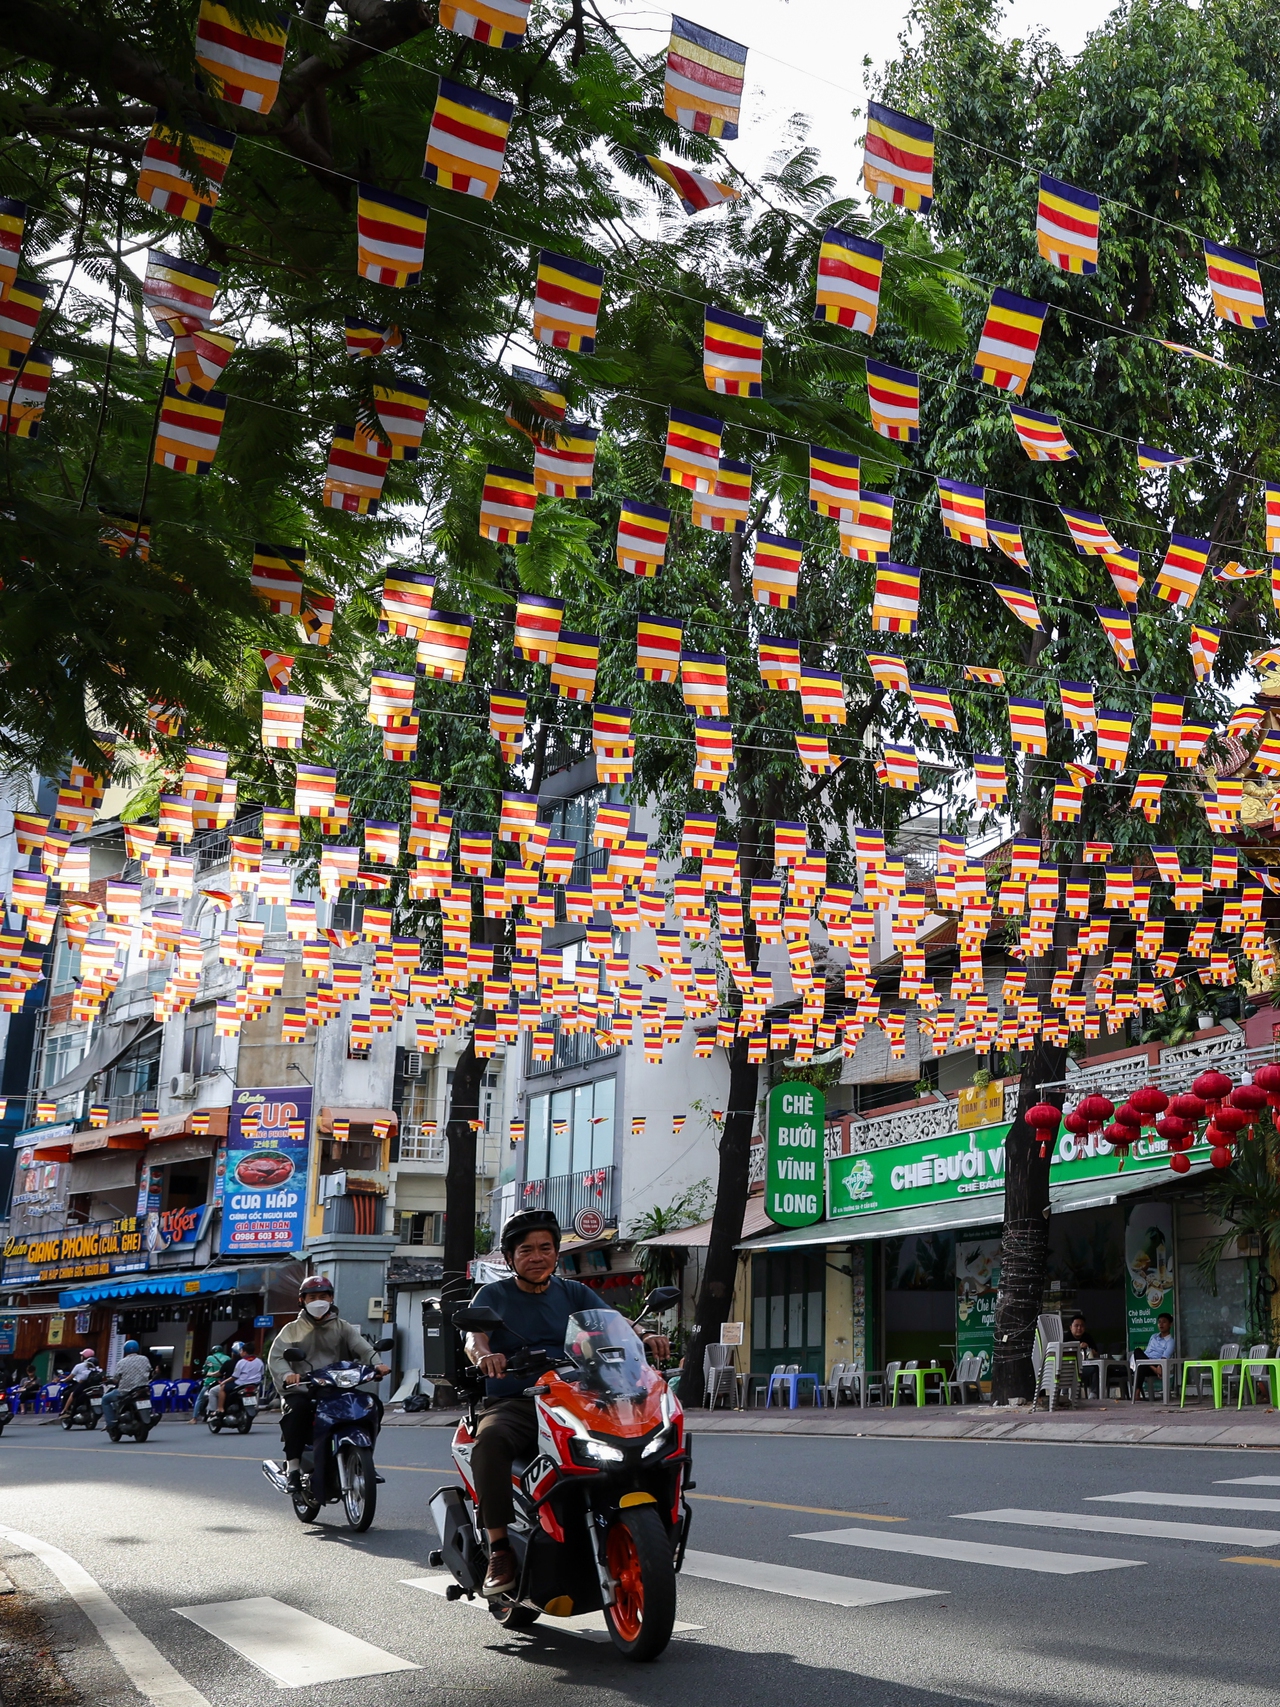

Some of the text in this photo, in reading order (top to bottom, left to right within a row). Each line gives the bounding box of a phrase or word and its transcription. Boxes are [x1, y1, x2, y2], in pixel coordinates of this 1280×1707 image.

[782, 1092, 814, 1115] CHÈ
[268, 1130, 289, 1138] PHON
[778, 1122, 816, 1148] BƯỞI
[777, 1157, 816, 1181] VĨNH
[890, 1154, 933, 1191] CHÈ
[934, 1133, 986, 1184] BƯỞI
[1051, 1128, 1115, 1164] ONG
[957, 1179, 980, 1193] CHÈ
[231, 1189, 298, 1210] CUA HẤP
[774, 1193, 817, 1214] LONG
[161, 1207, 197, 1242] Tiger
[258, 1232, 272, 1240] 603
[274, 1231, 288, 1239] 503
[3, 1236, 28, 1257] Quán
[28, 1240, 59, 1263] GIANG
[61, 1233, 99, 1260] PHONG
